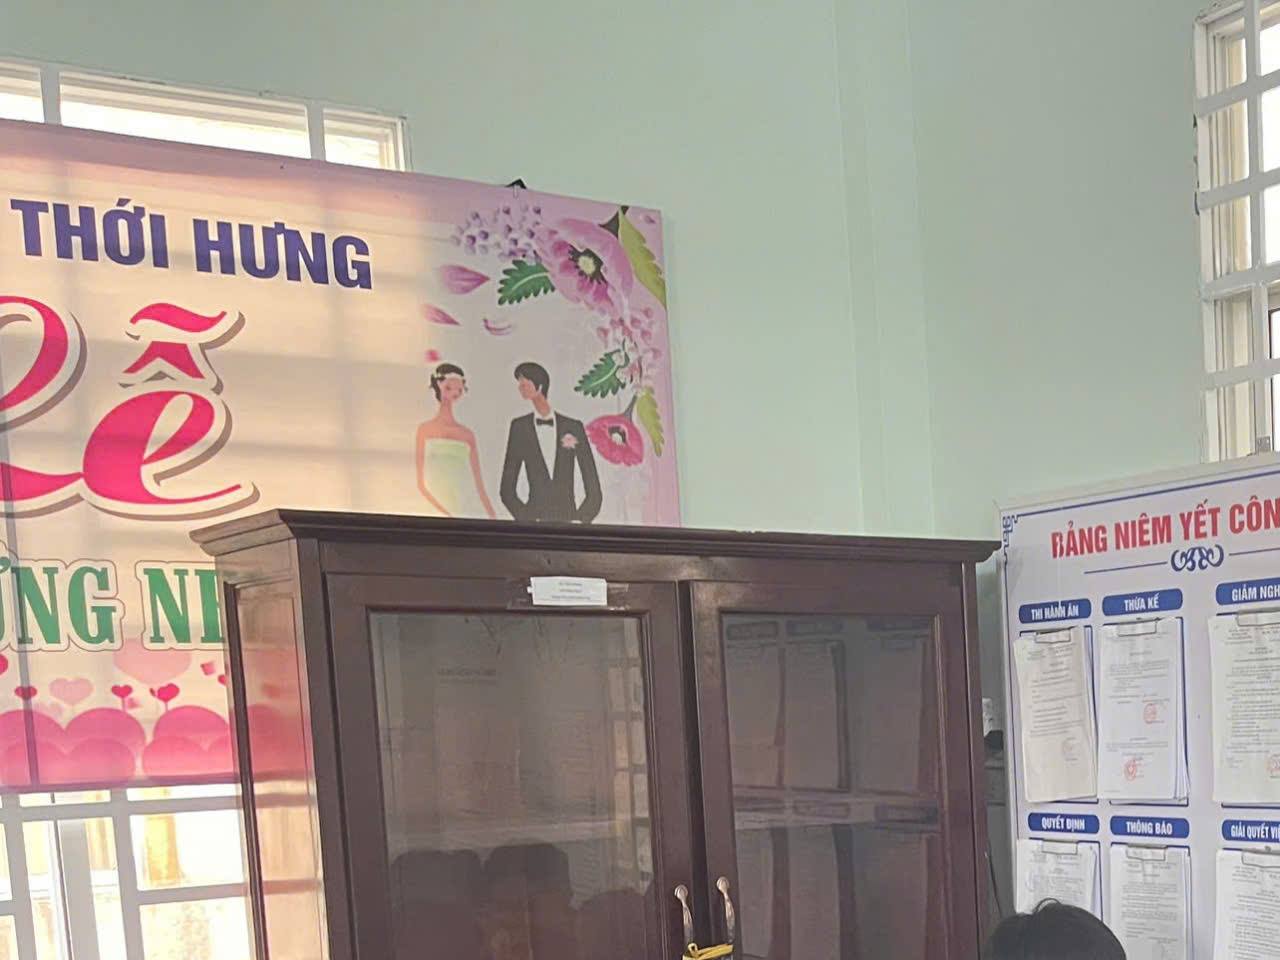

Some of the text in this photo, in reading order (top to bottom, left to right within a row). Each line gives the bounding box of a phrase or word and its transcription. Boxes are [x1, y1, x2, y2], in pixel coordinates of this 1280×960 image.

[11, 198, 373, 290] THỚI HƯNG
[1050, 521, 1108, 559] BẢNG
[1114, 513, 1173, 551] NIÊM
[1178, 500, 1221, 540] YẾT
[1148, 593, 1159, 609] KẾ
[1231, 584, 1257, 602] GIẢM
[1031, 609, 1043, 621] THI
[1067, 603, 1079, 616] ÁN
[1042, 816, 1085, 832] QUYẾT ĐỊNH
[1126, 819, 1173, 835] THÔNG BÁO
[1231, 822, 1245, 838] GIẢI
[1247, 823, 1269, 839] QUYẾT
